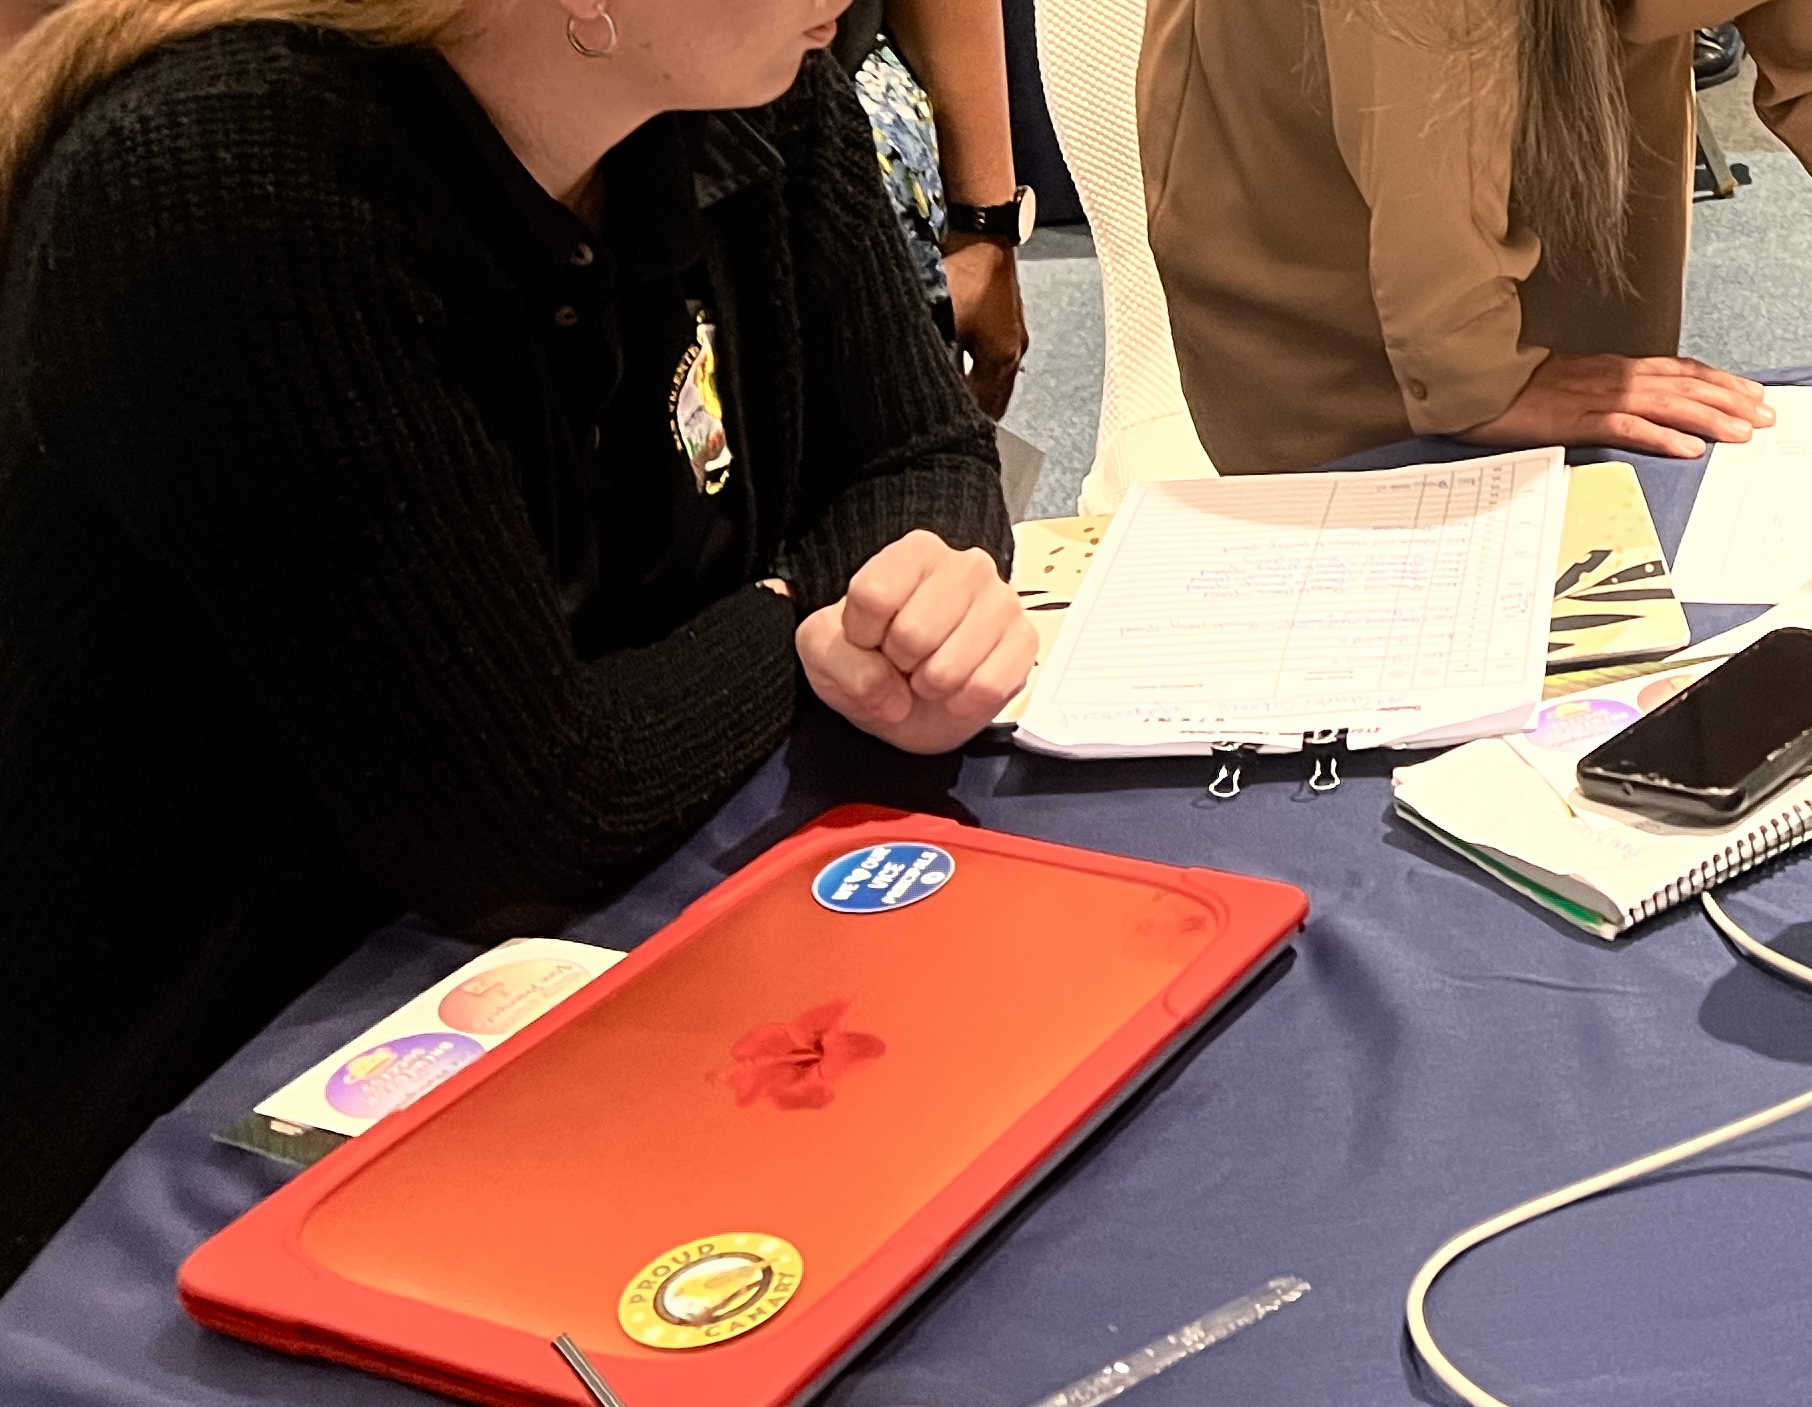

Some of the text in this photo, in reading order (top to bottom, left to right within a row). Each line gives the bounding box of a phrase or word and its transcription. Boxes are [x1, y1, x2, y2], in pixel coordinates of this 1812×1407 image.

[860, 847, 891, 870] OUR
[867, 862, 906, 889] VICE
[628, 1243, 715, 1306] PROUD
